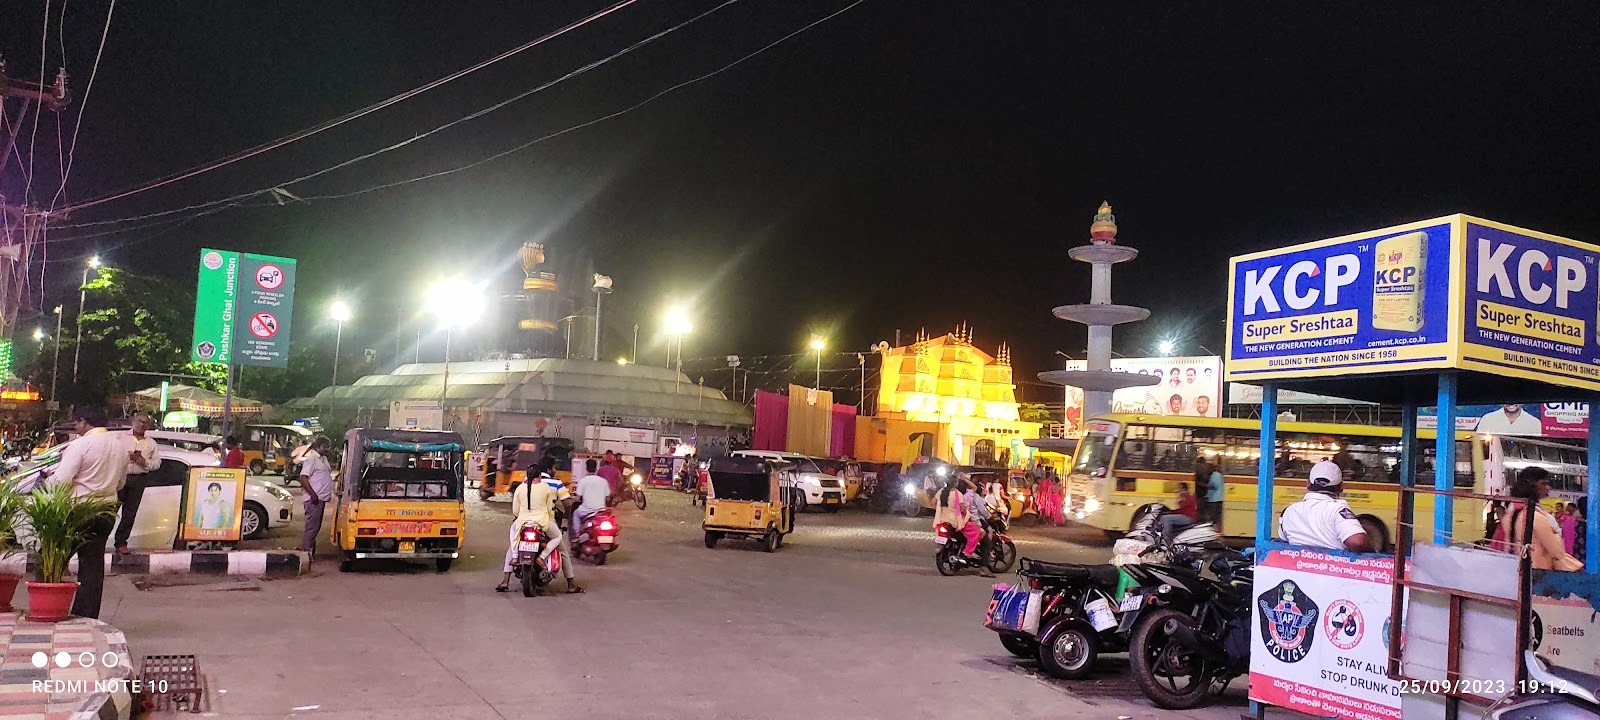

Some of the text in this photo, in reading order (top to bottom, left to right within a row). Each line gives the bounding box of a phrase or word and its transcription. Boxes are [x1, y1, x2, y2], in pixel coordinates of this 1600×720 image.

[1244, 245, 1369, 316] KCP TM
[1376, 267, 1415, 284] KCP
[1477, 238, 1593, 309] KCP TM
[219, 258, 236, 360] Pushkar Ghat Junction
[1246, 316, 1353, 339] Super Sreshtaa
[1480, 304, 1581, 338] Super Sreshtaa
[1245, 336, 1354, 353] THE NEW GENERATION CEMENT
[1368, 335, 1426, 347] cement.kcp.co.in
[1479, 330, 1582, 355] THE NEW GENERATION CEMENT
[1269, 350, 1397, 366] BUILDING THE NATION SINCE 1958
[1504, 353, 1599, 376] BUILDING THE NATION SINCE
[1282, 613, 1293, 623] AP
[1547, 624, 1585, 637] Seatbelts
[1266, 638, 1306, 662] POLICE
[1547, 645, 1560, 655] Are
[1337, 656, 1362, 670] STAY
[1320, 670, 1348, 683] STOP
[1350, 676, 1388, 695] DRUNK
